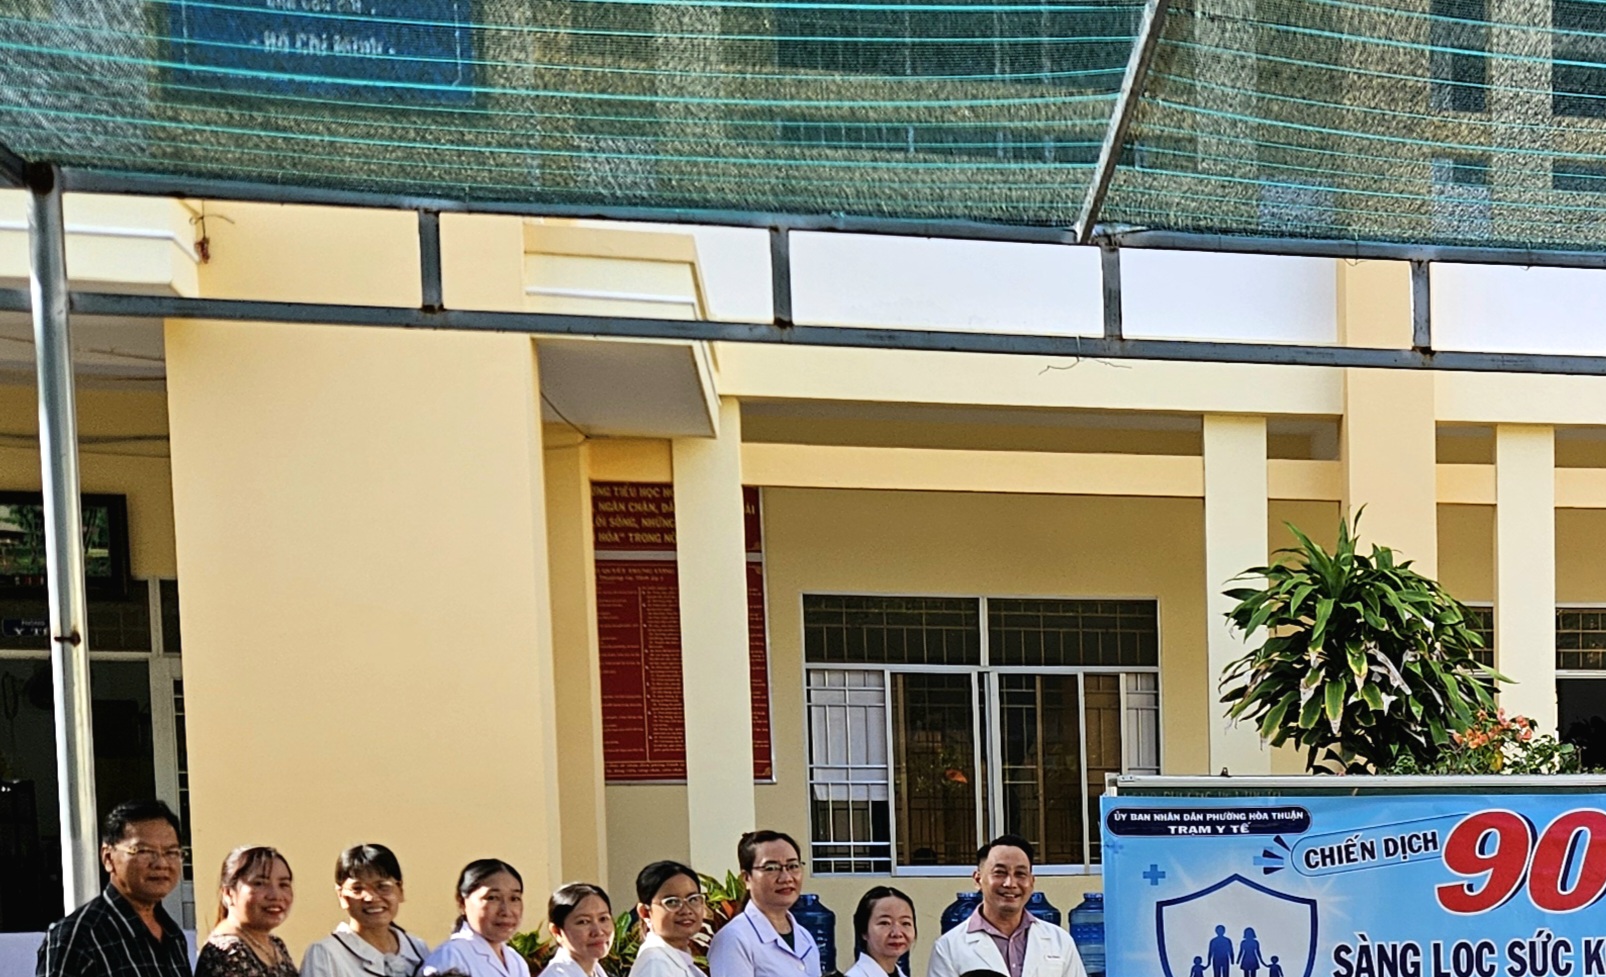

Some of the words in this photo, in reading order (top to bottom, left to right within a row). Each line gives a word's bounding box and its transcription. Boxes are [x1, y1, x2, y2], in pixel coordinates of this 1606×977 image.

[627, 532, 663, 543] TRONG
[1114, 810, 1128, 821] ỦY
[1130, 813, 1151, 821] BAN
[1153, 811, 1181, 822] NHÂN
[1183, 811, 1203, 821] DÂN
[1206, 810, 1247, 821] PHƯỜNG
[1249, 810, 1269, 821] HÒA
[1271, 810, 1304, 822] THUẬN
[1167, 825, 1212, 836] TRẠM
[1215, 825, 1226, 834] Y
[1229, 821, 1252, 834] TẾ
[1304, 832, 1377, 870] CHIẾN
[1383, 831, 1439, 862] DỊCH
